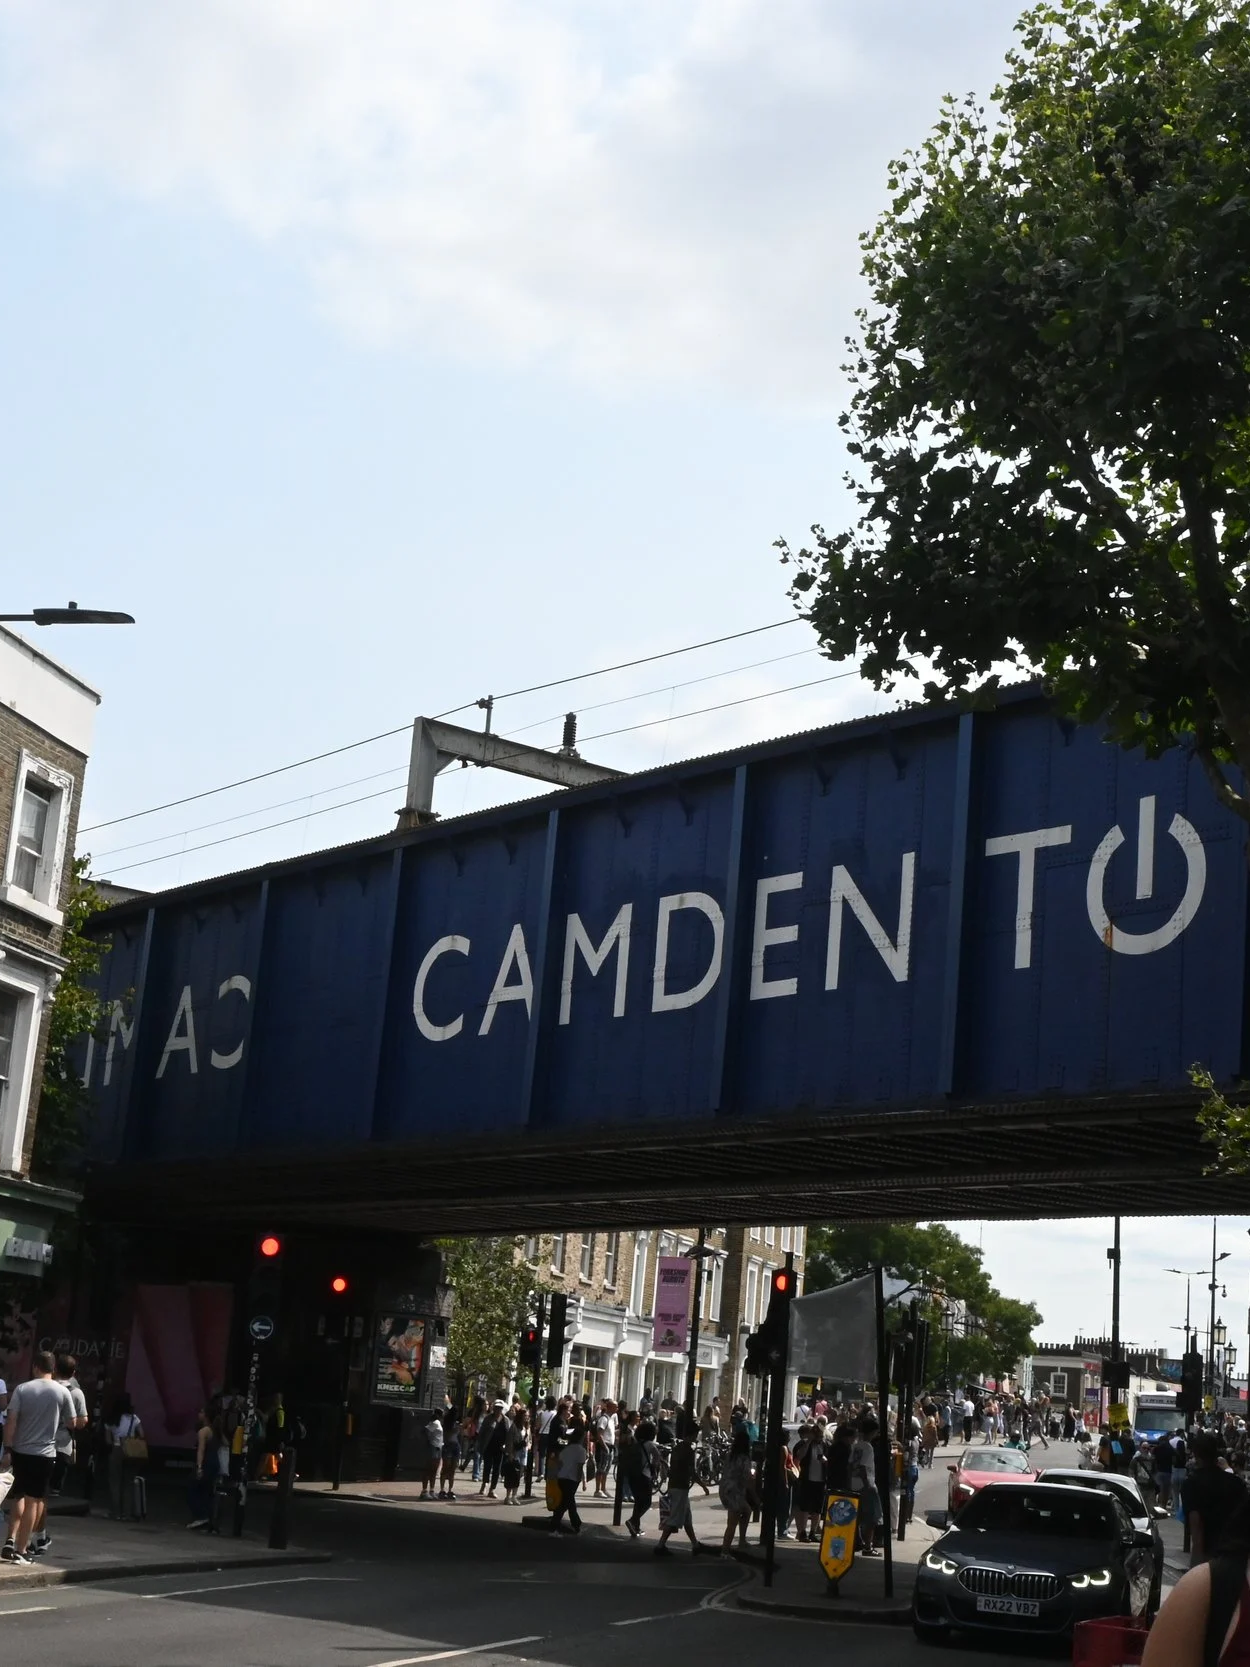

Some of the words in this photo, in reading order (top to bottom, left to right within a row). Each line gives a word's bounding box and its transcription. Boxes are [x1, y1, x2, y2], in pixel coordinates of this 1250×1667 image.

[414, 852, 916, 1042] CAMDEN
[39, 1336, 125, 1359] CAUDAIE
[377, 1383, 416, 1392] KNEECAP
[984, 1599, 1013, 1612] RX22
[1016, 1602, 1037, 1615] VBZ
